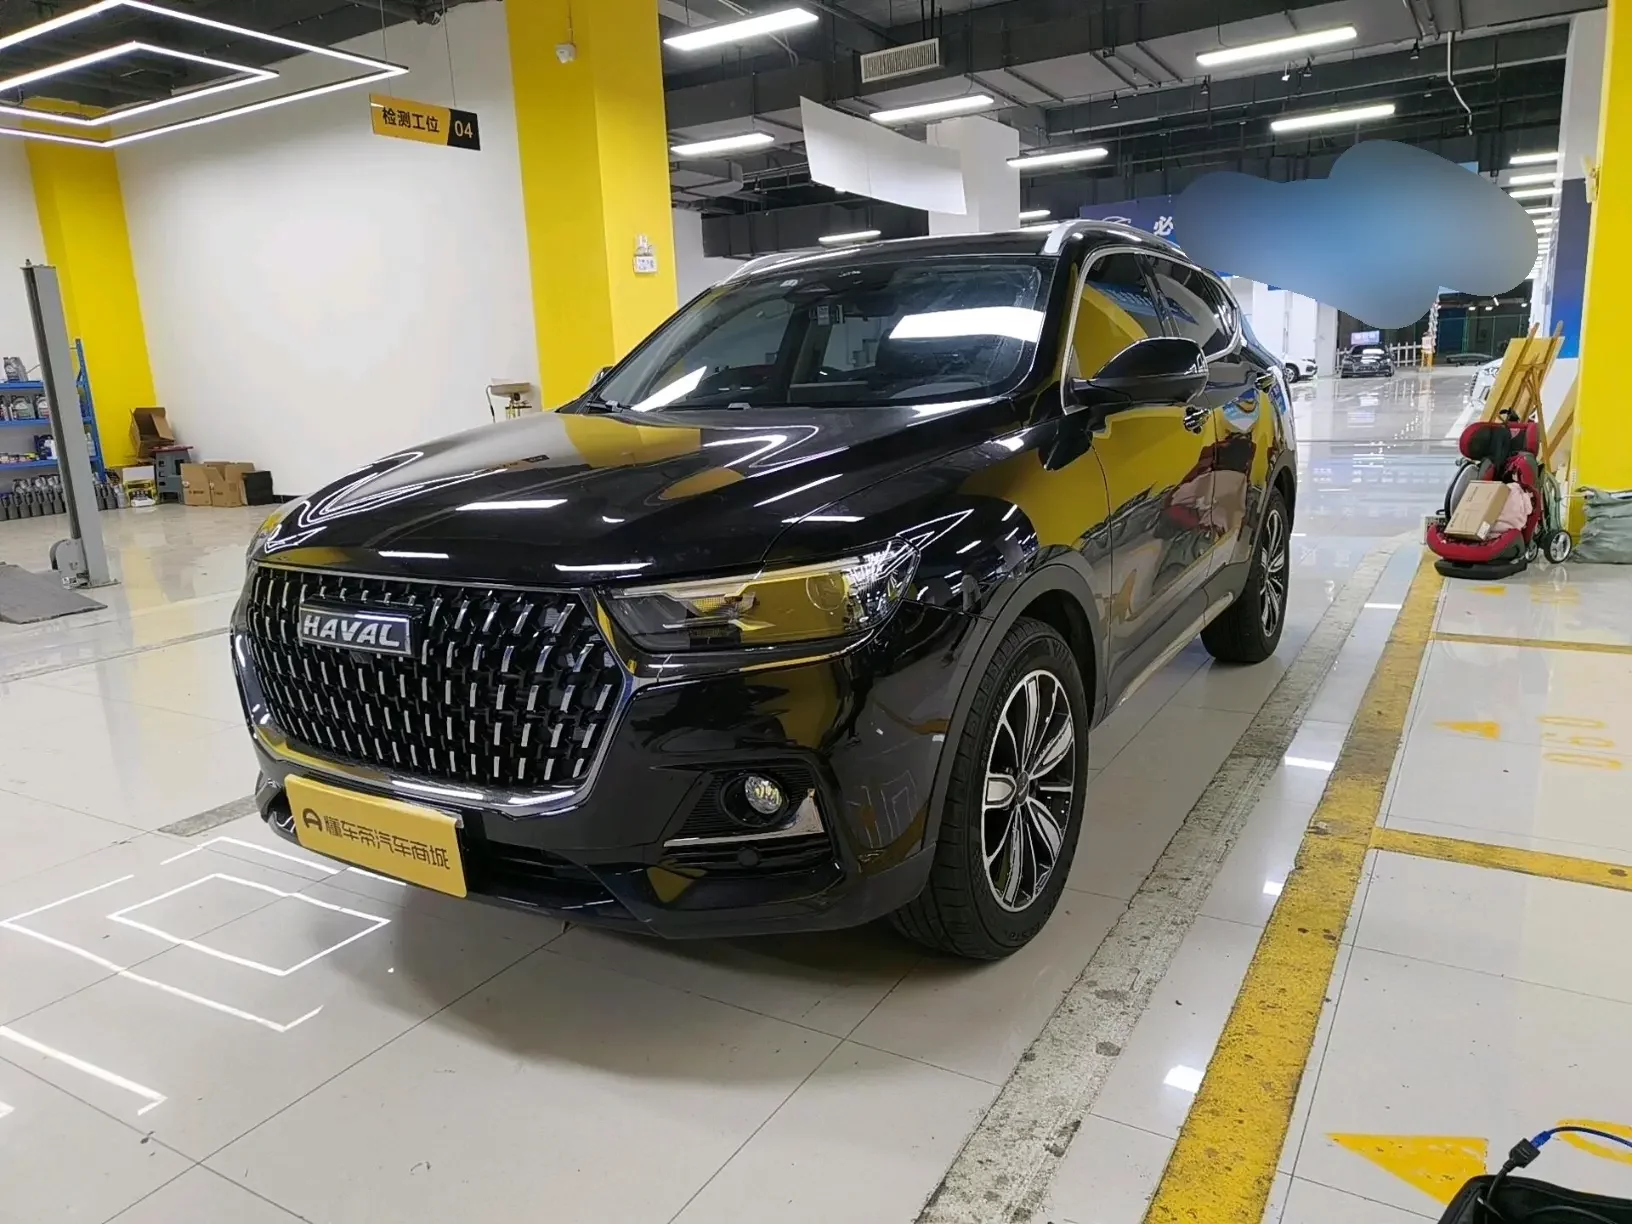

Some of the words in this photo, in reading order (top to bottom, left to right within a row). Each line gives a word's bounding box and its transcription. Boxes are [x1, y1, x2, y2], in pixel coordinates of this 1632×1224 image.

[382, 106, 440, 133] 检测工位
[454, 120, 473, 139] 04
[302, 614, 400, 647] HAVAL
